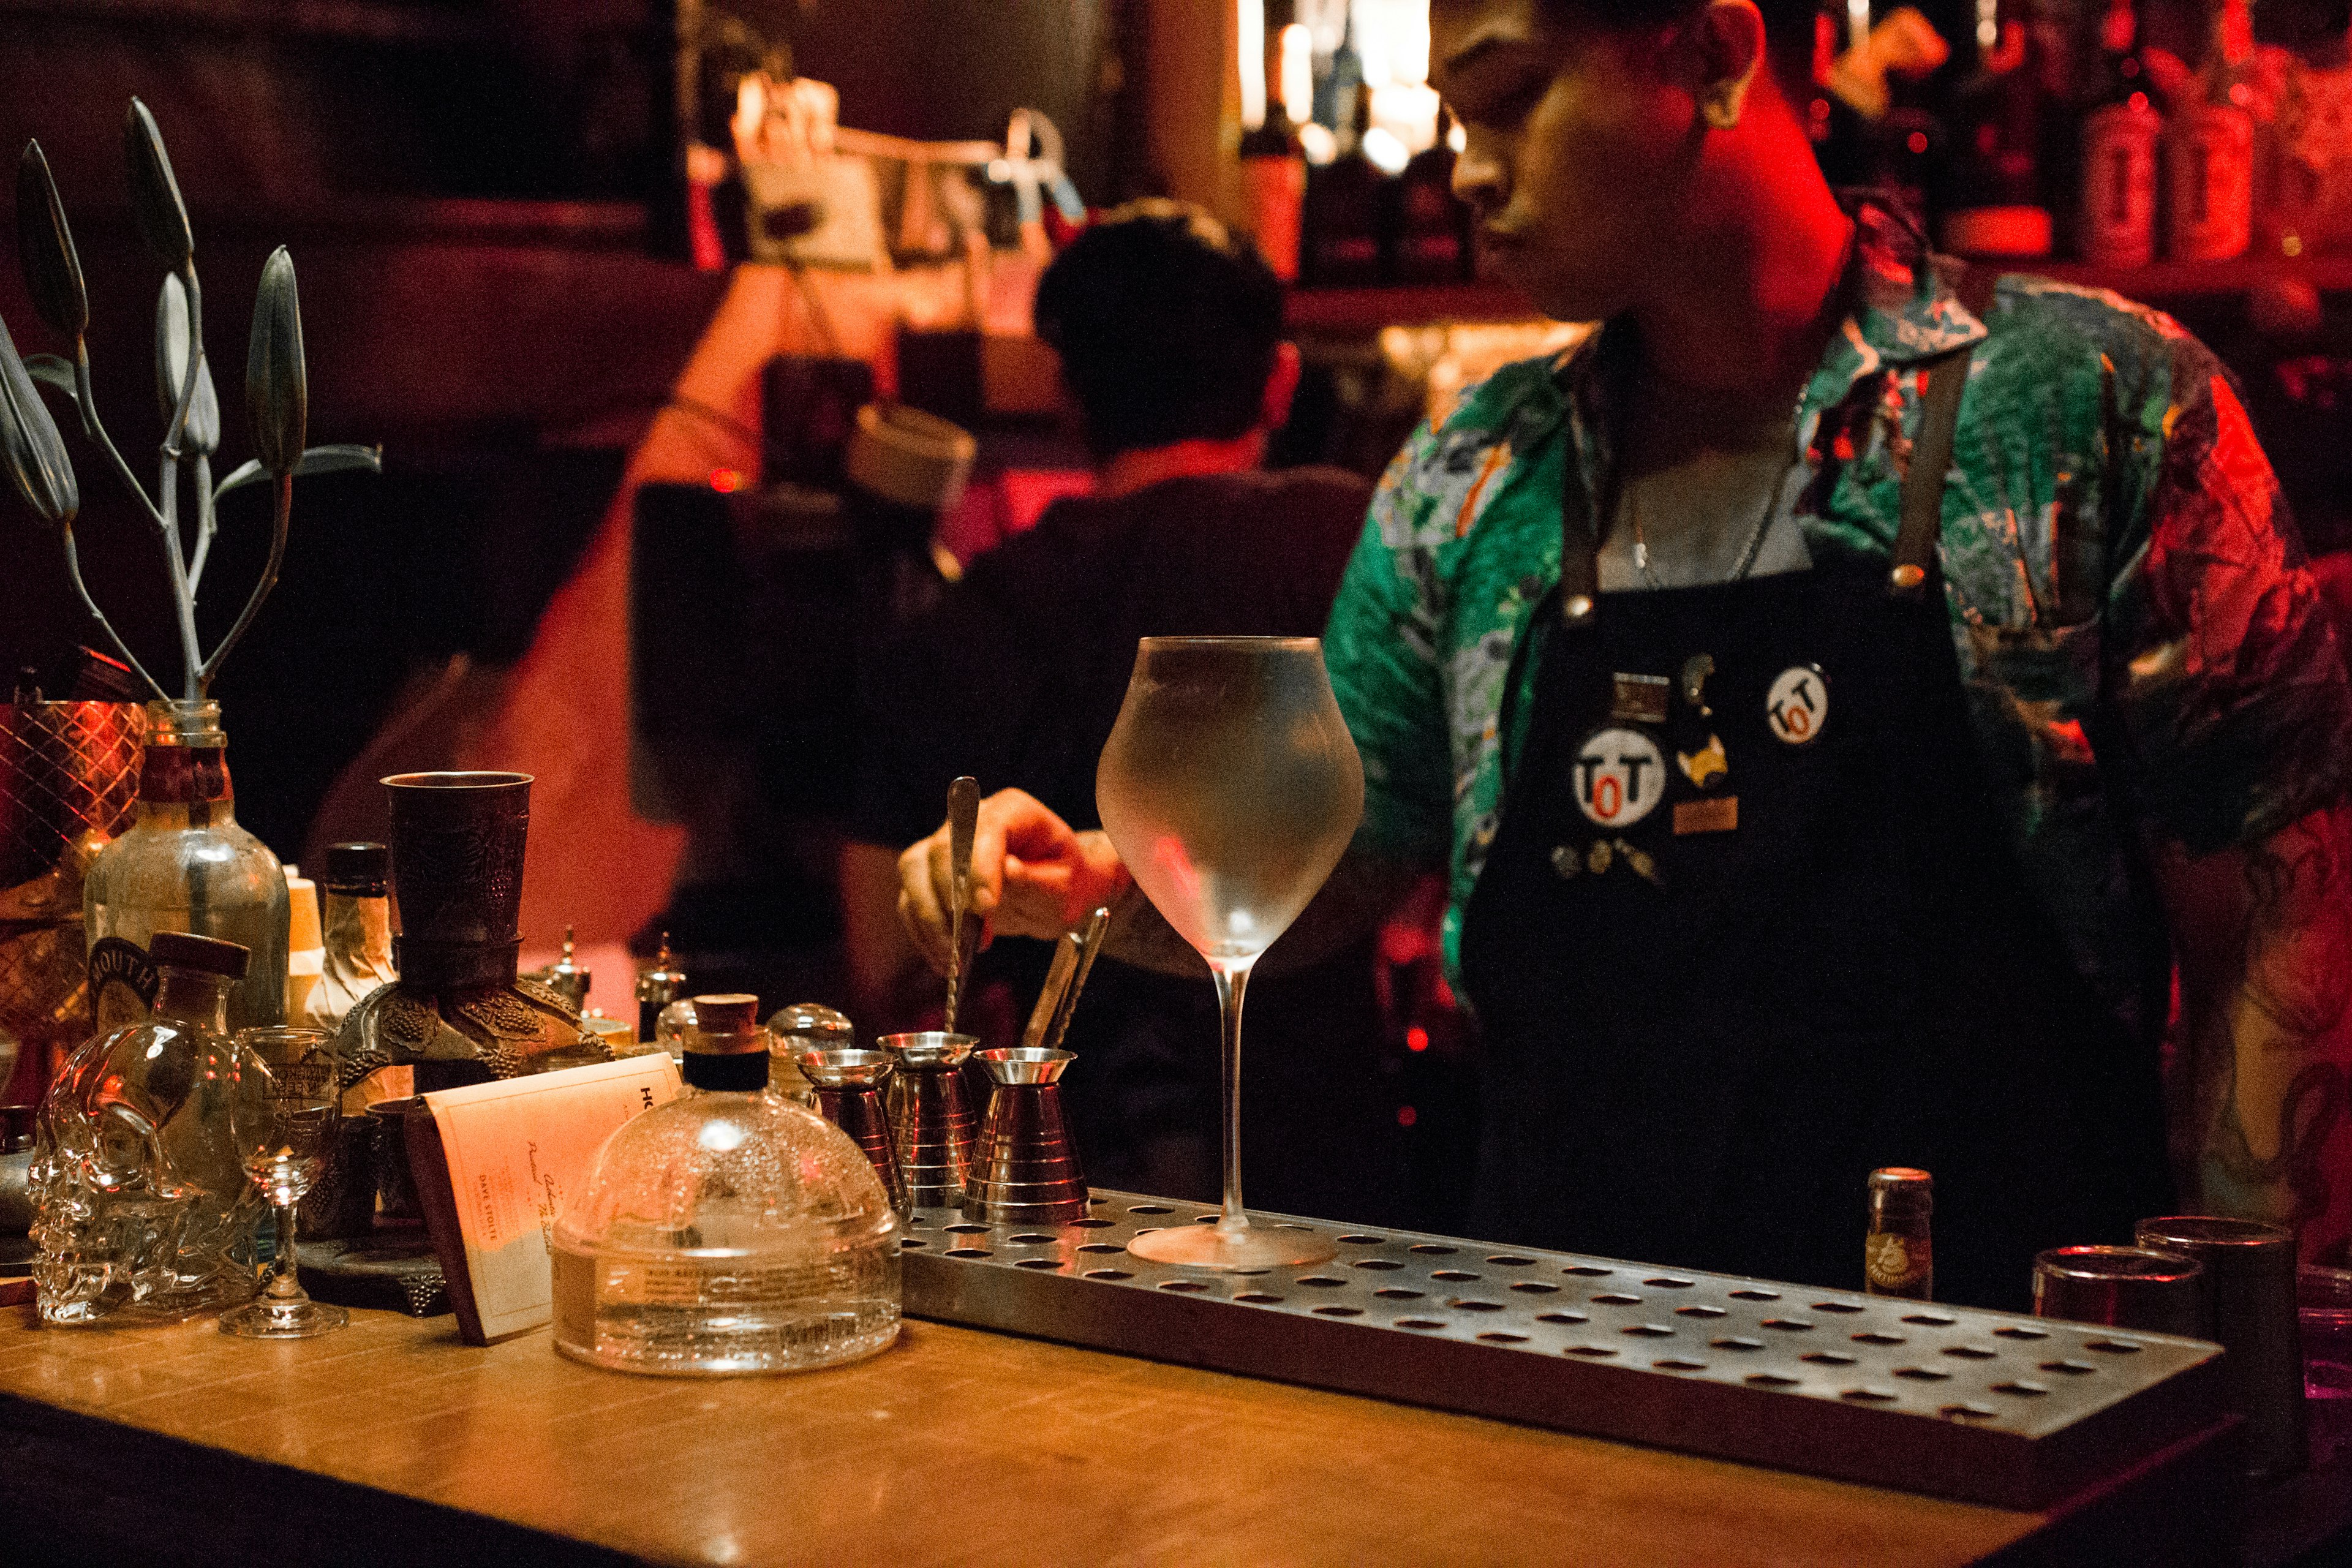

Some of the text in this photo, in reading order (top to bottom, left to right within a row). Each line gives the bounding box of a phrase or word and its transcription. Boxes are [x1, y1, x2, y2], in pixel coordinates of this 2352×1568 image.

[91, 949, 156, 992] MOUTH
[479, 1174, 489, 1199] DAVE
[485, 1204, 497, 1242] STOLTE
